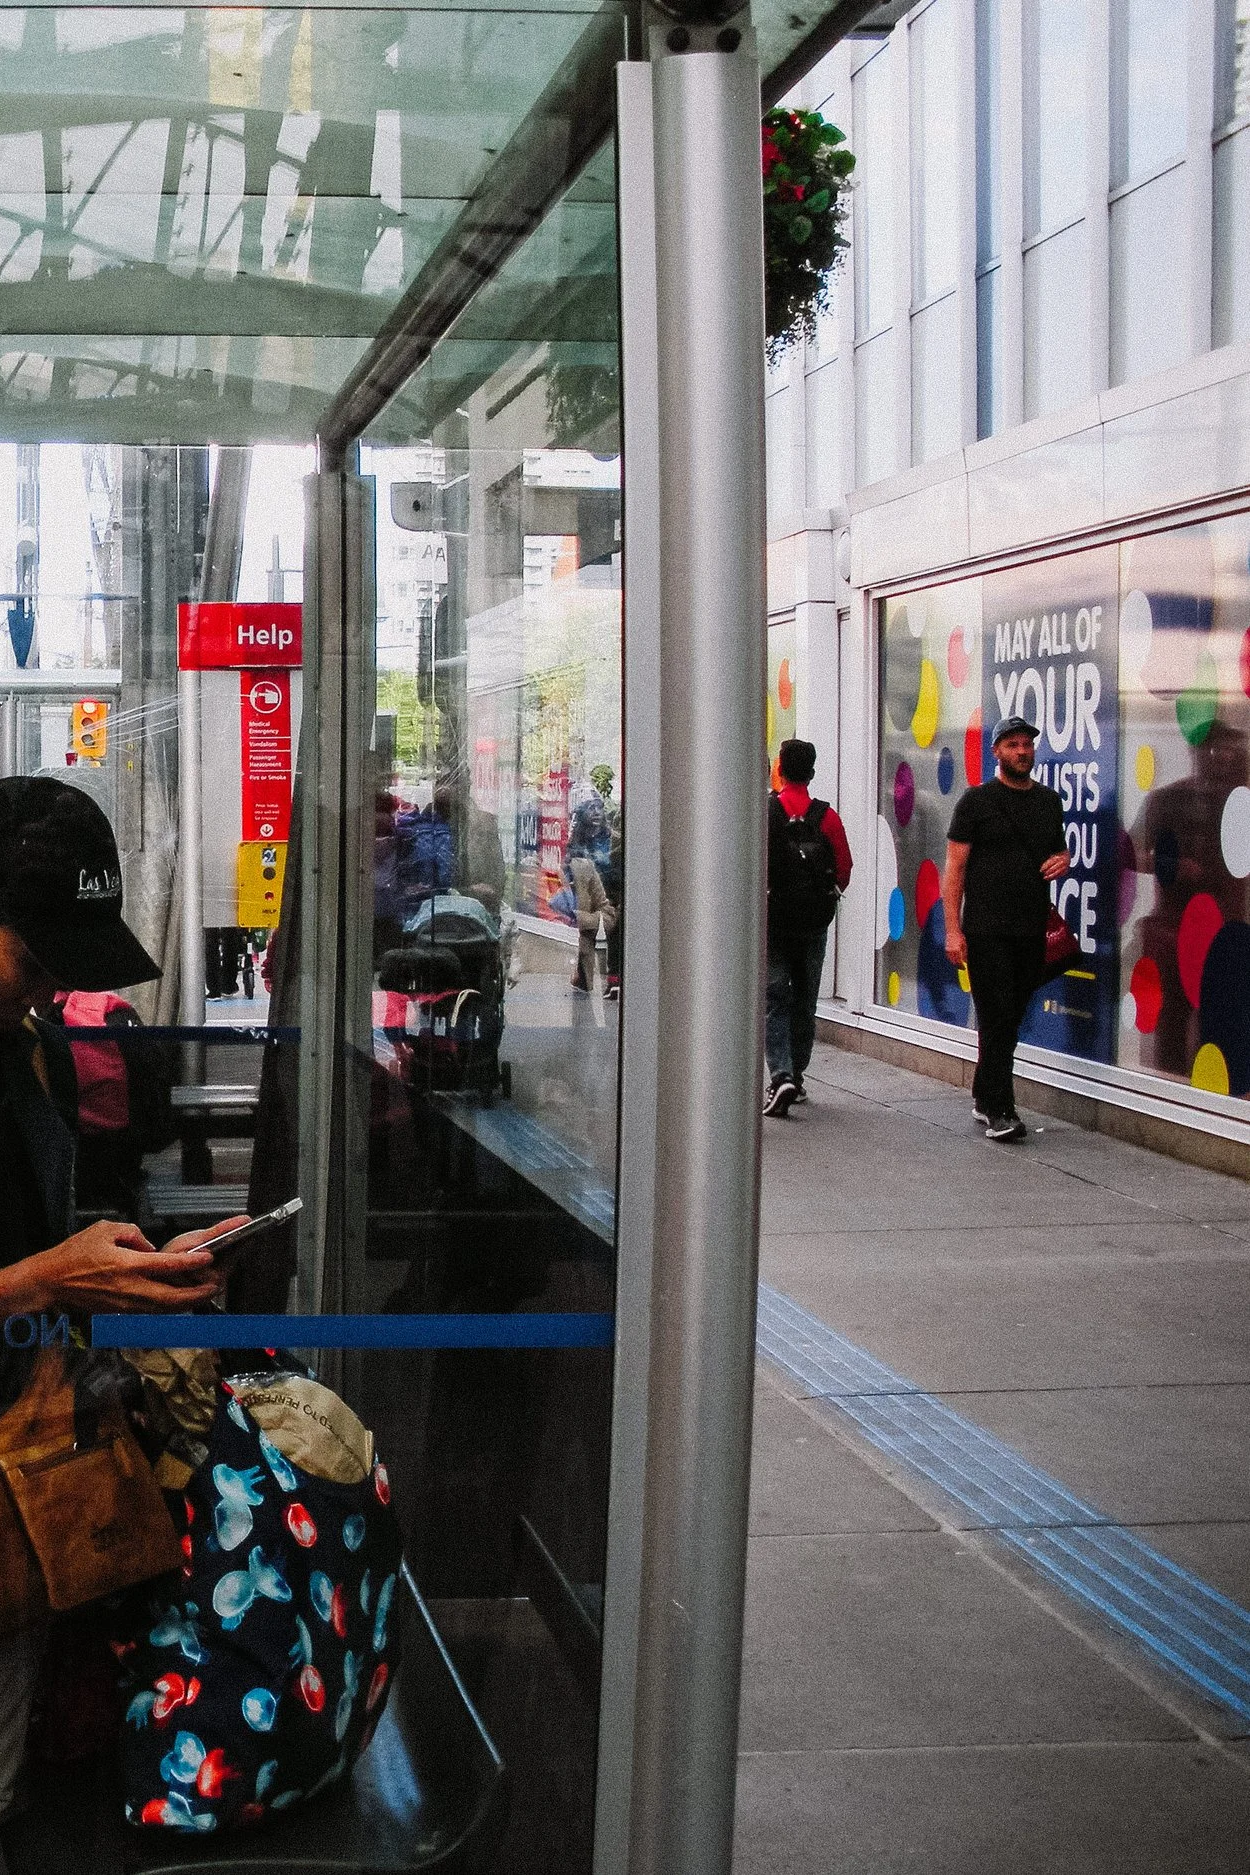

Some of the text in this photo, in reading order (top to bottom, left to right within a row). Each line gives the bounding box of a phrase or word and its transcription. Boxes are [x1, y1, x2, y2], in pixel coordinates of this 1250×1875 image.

[237, 623, 294, 650] Help
[994, 605, 1103, 664] MAY ALL OF
[994, 662, 1102, 753] YOUR
[1063, 821, 1098, 869] OU
[303, 1404, 317, 1421] TO
